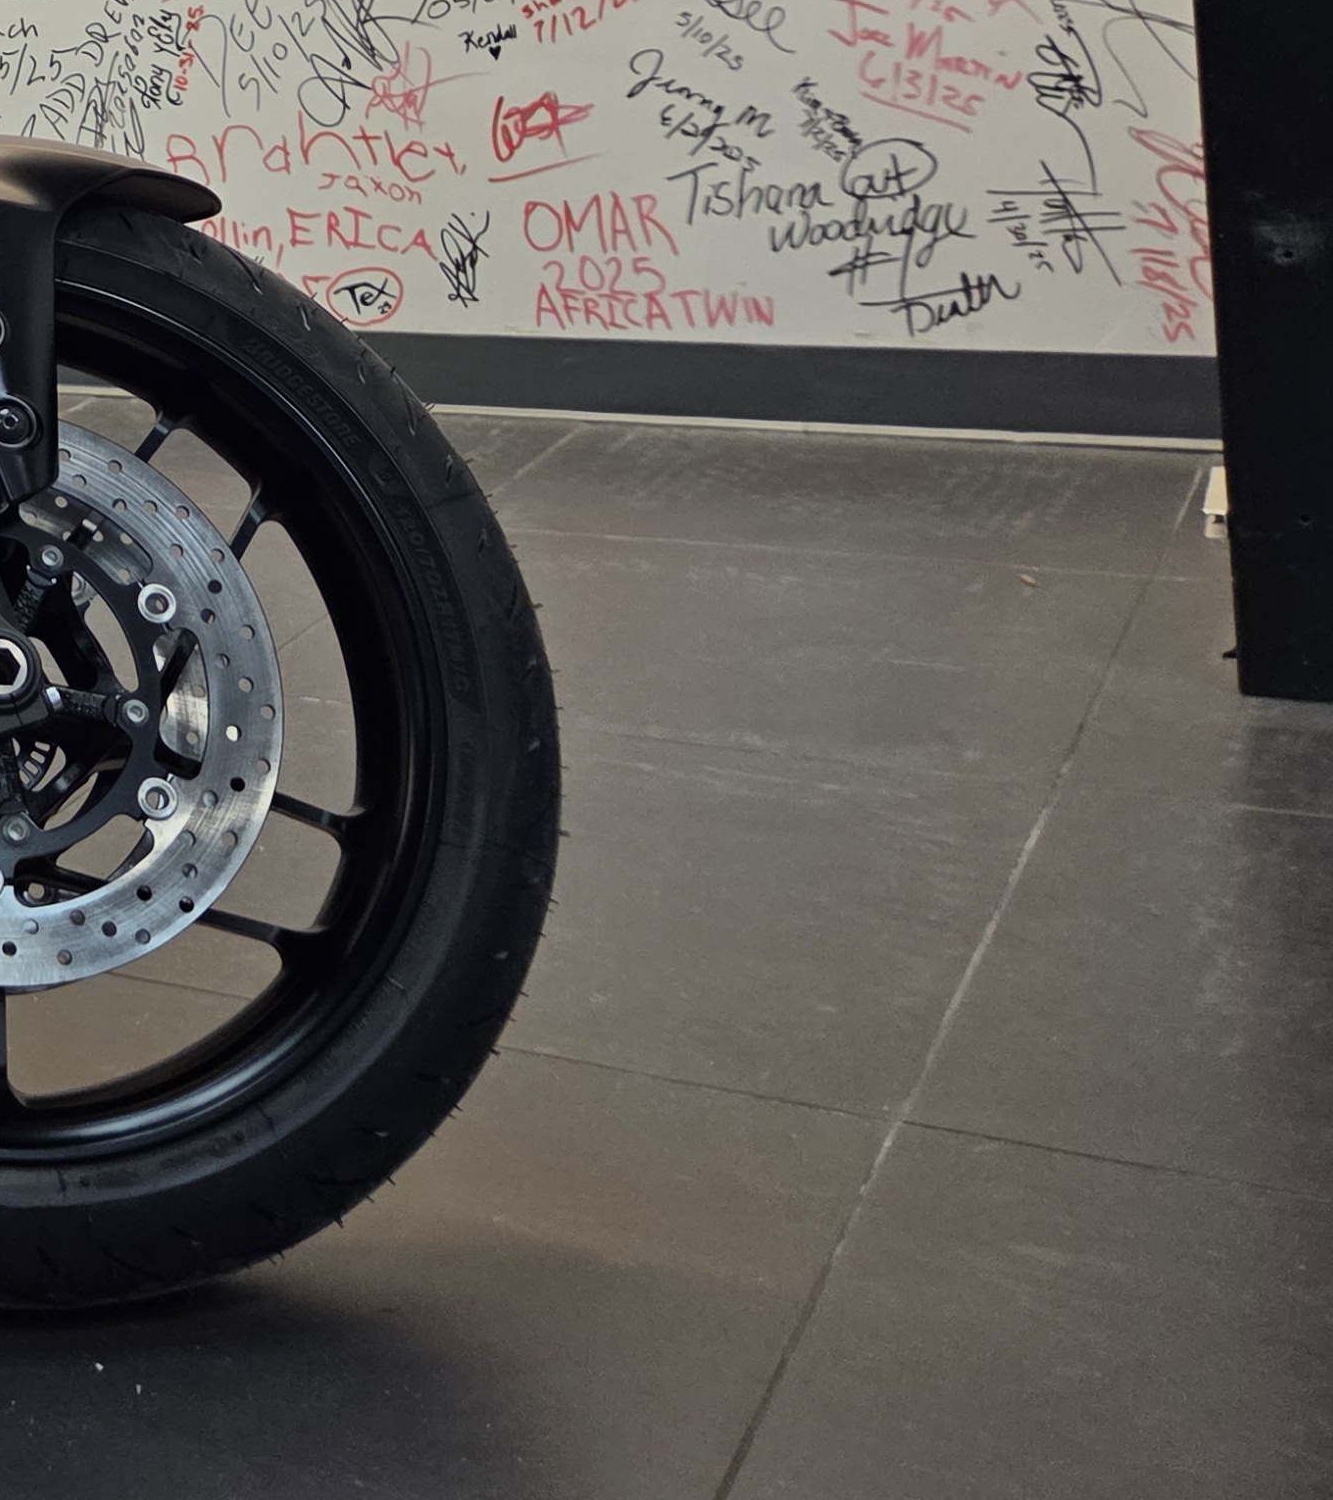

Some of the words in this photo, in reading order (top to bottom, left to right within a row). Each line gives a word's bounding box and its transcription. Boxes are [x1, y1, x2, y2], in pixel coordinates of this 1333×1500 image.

[287, 206, 437, 261] ERICA
[524, 192, 679, 256] OMAR
[543, 256, 667, 297] 2025
[537, 283, 672, 331] AFRICA
[670, 288, 774, 328] TWIN
[243, 338, 362, 448] BRIDGESTONE
